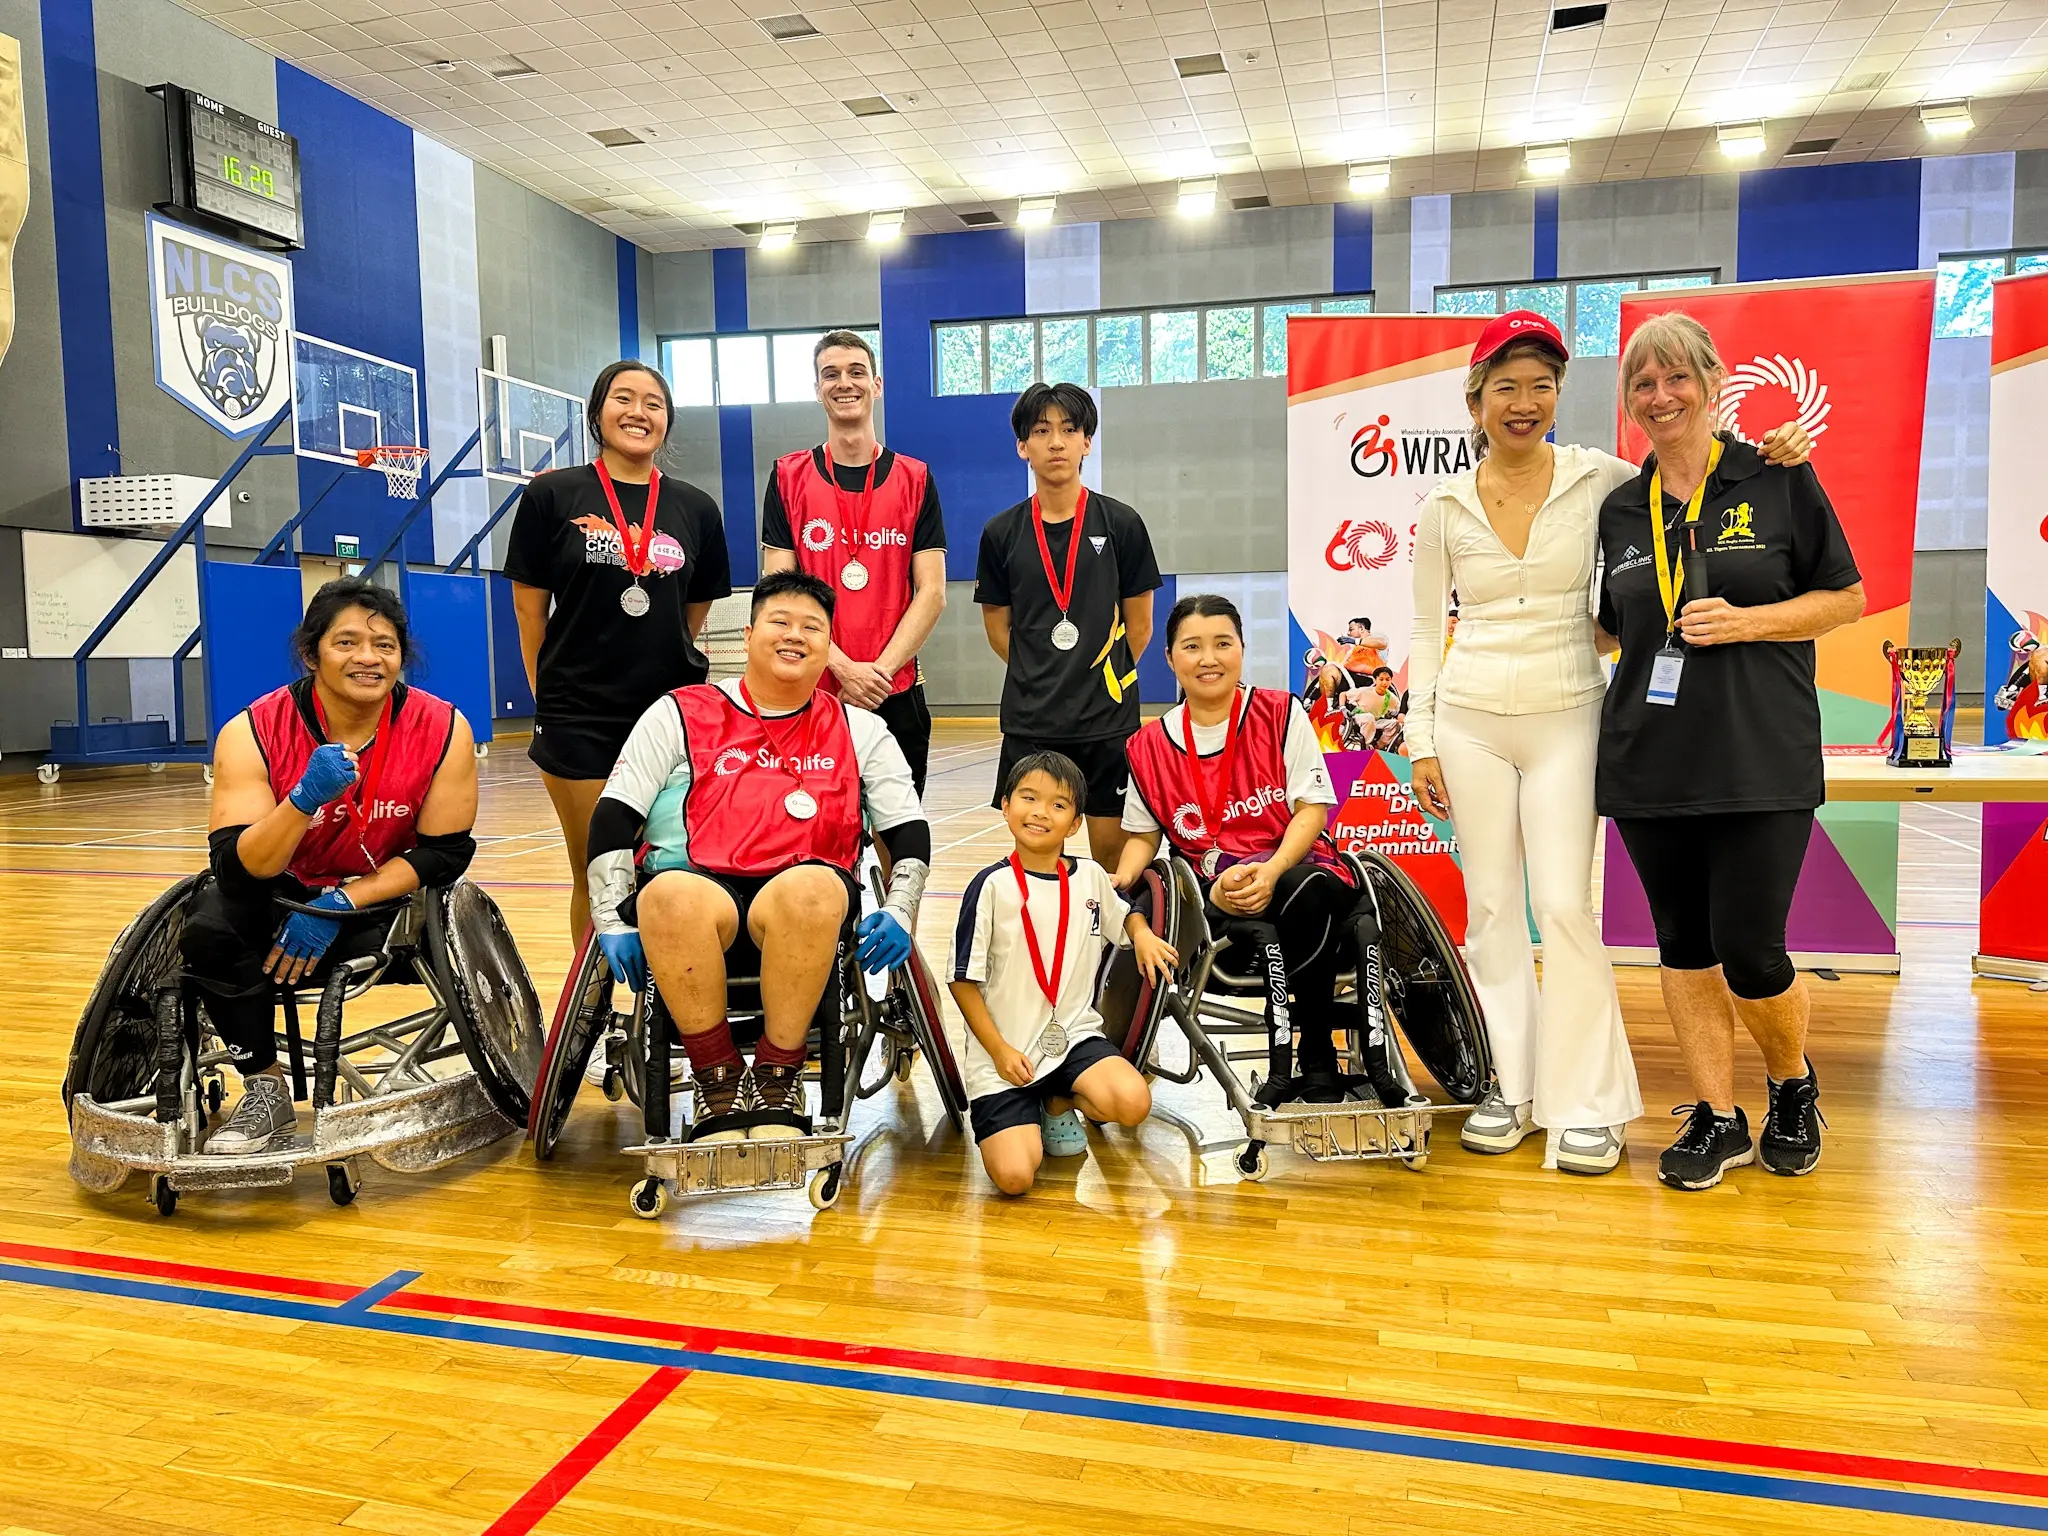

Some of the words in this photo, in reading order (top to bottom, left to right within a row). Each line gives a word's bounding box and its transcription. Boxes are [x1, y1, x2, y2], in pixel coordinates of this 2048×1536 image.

[197, 95, 225, 115] HOME
[257, 122, 286, 141] GUEST
[165, 241, 281, 321] NLCS
[174, 296, 278, 340] BULLDOGS
[341, 544, 355, 555] EXIT
[1335, 819, 1434, 842] Inspiring
